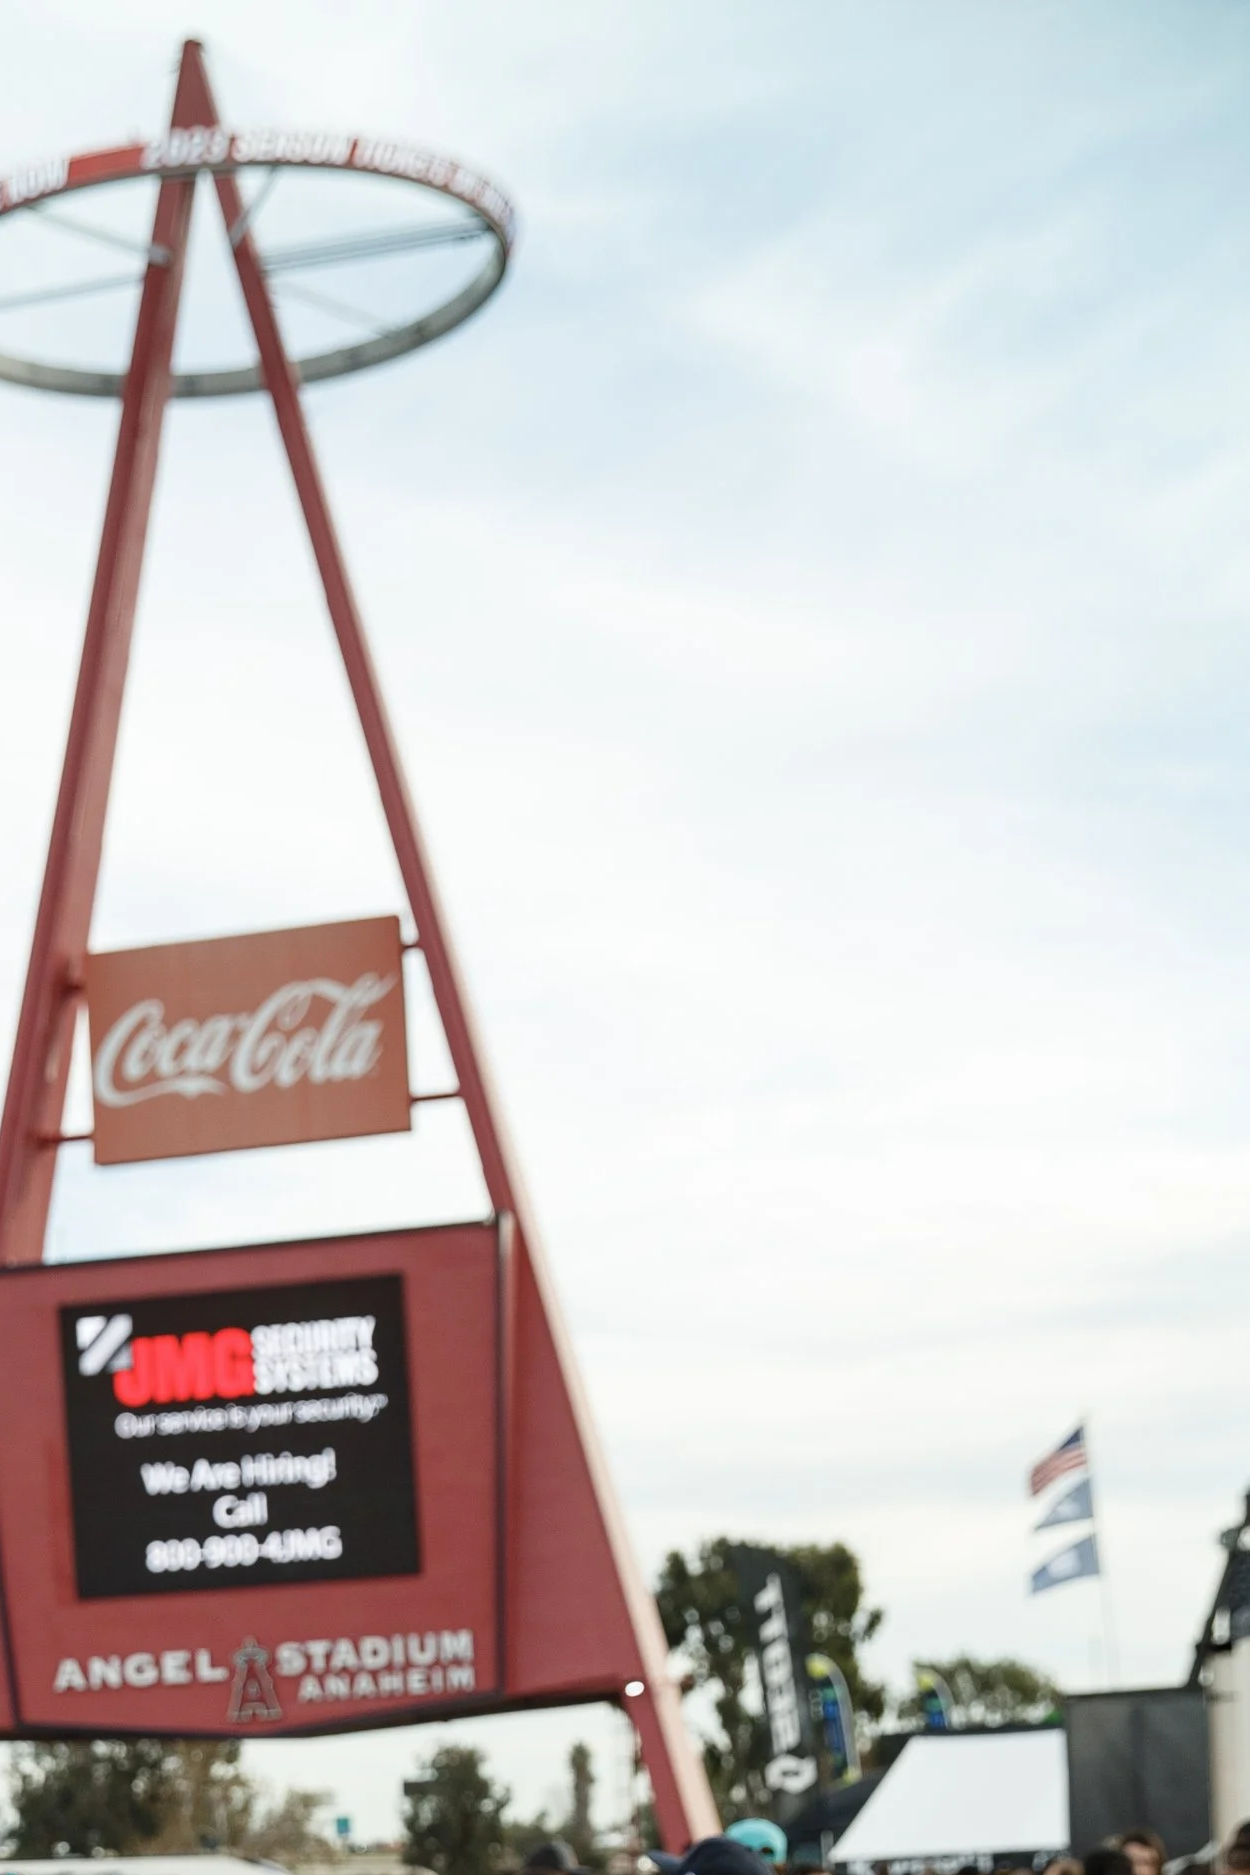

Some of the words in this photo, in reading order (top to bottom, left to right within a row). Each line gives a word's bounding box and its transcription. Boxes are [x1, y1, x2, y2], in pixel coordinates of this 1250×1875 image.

[113, 1327, 254, 1407] JMG
[140, 1461, 190, 1496] We
[190, 1457, 241, 1492] Are
[240, 1446, 337, 1489] Hiring!
[212, 1491, 268, 1529] Call
[53, 1650, 230, 1692] ANGEL
[274, 1629, 475, 1677] STADIUM
[297, 1665, 476, 1702] ANAHEIM
